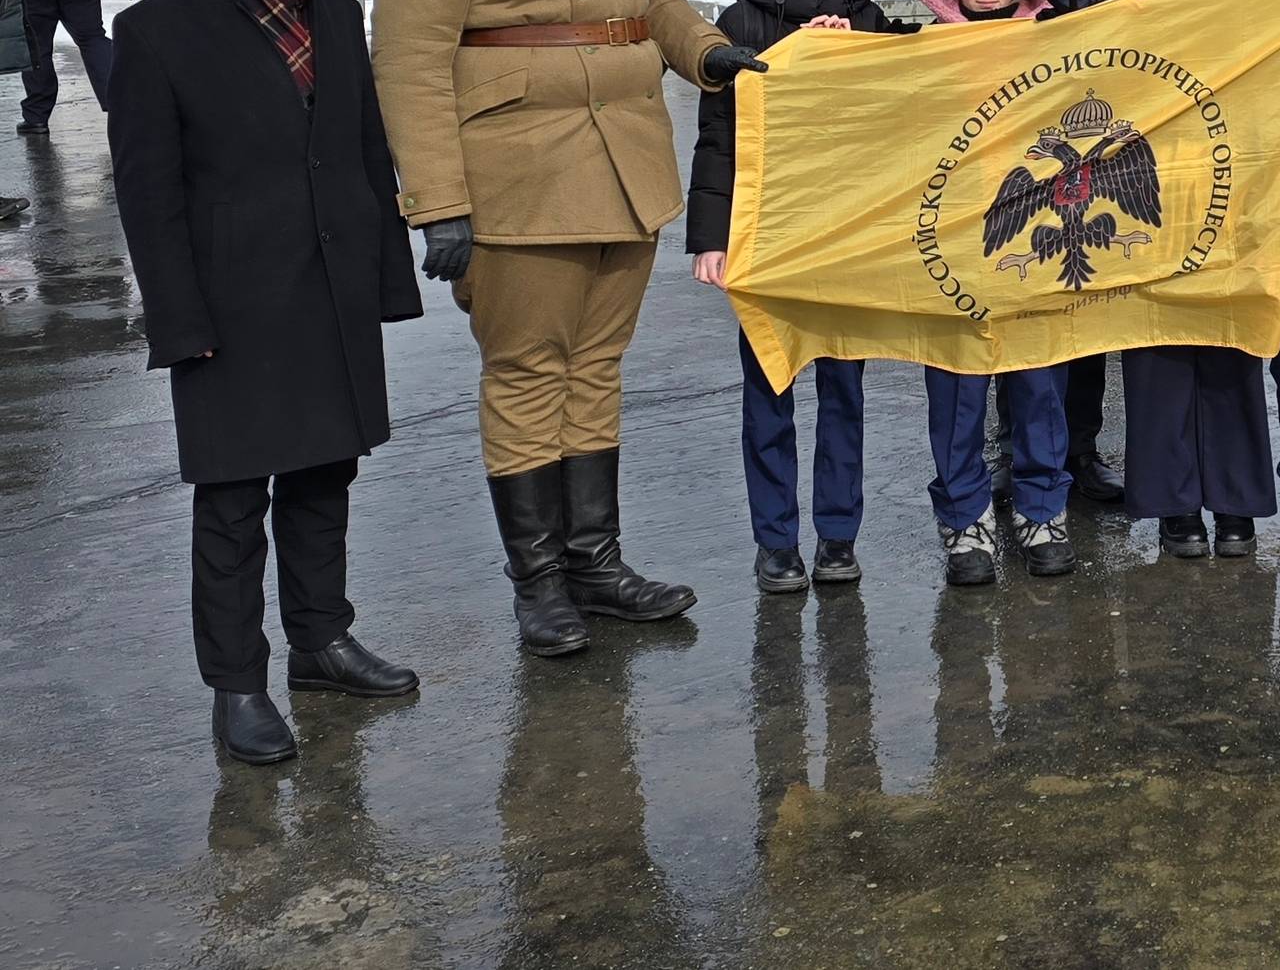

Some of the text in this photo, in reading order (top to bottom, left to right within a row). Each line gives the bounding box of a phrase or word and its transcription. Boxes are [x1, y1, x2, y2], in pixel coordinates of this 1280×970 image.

[911, 47, 1232, 321] РОССИЙСКОЕ ВОЕННО-ИСТОРИЧЕСОЕ ОБЩЕСТВ
